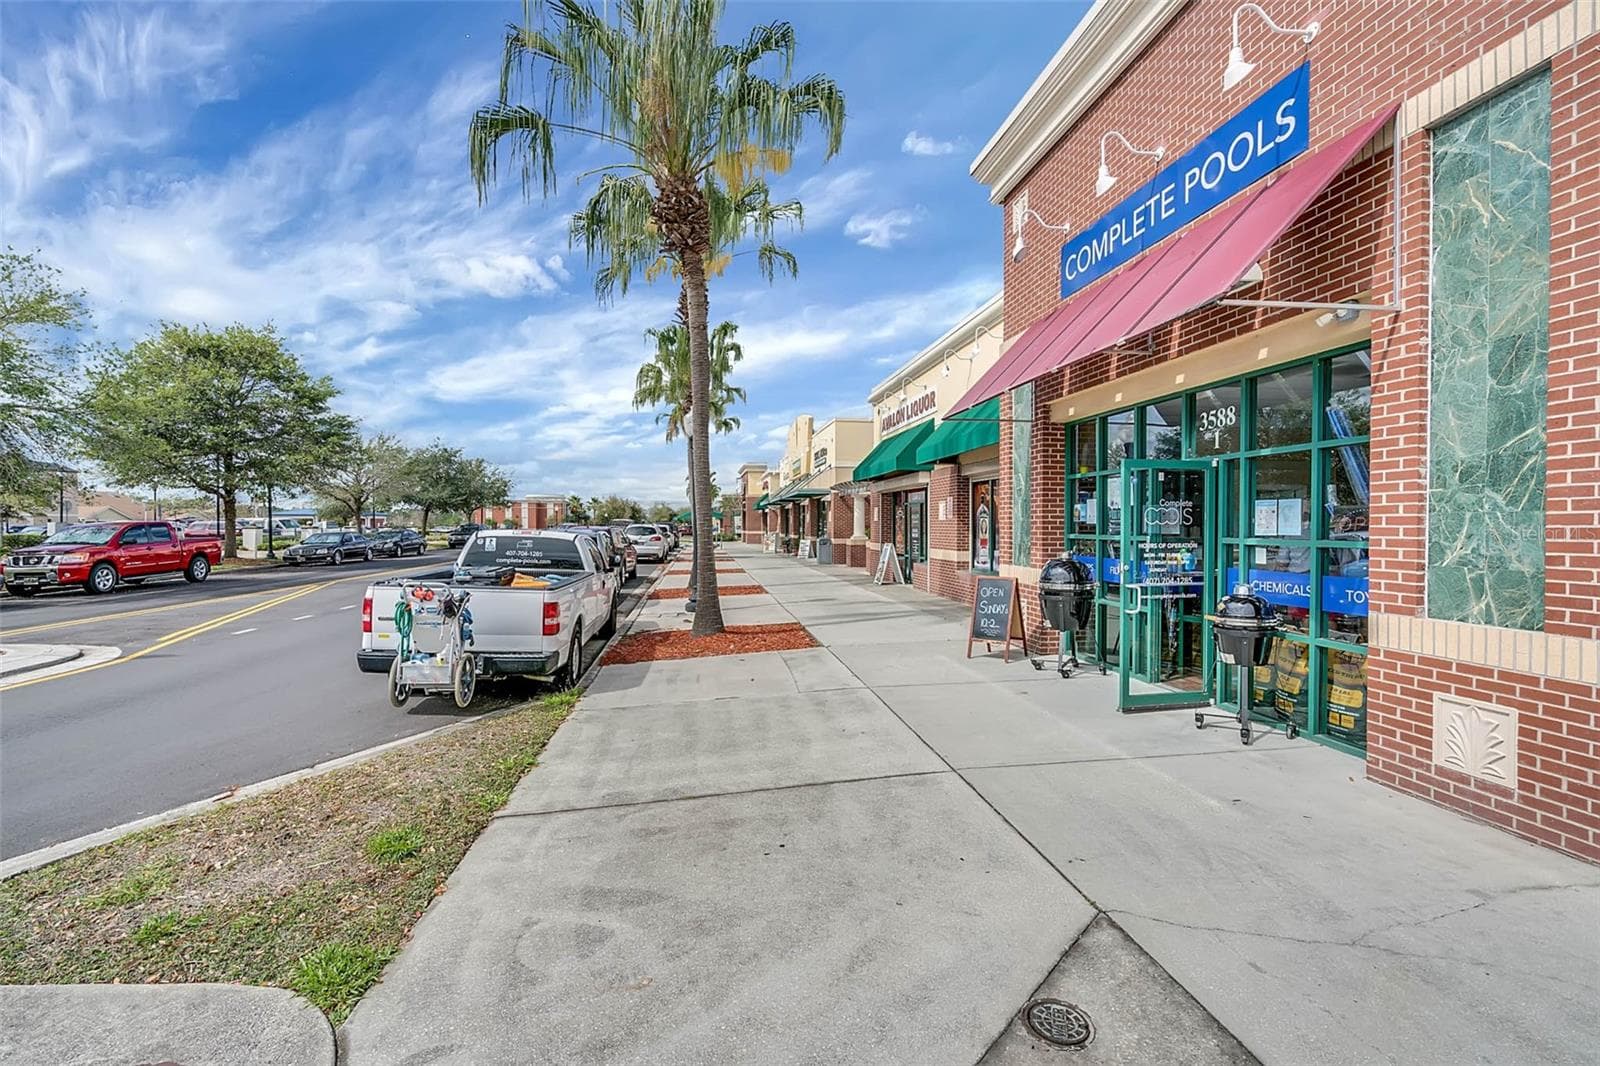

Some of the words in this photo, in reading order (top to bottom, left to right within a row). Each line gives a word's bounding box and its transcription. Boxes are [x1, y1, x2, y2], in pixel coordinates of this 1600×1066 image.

[1064, 183, 1176, 281] COMPLETE
[1184, 97, 1297, 205] POOLS
[881, 406, 905, 433] AVALON
[906, 390, 936, 420] LIQUOR
[1199, 405, 1236, 431] 3588
[1159, 498, 1193, 508] Complete
[980, 587, 1004, 598] OPEN
